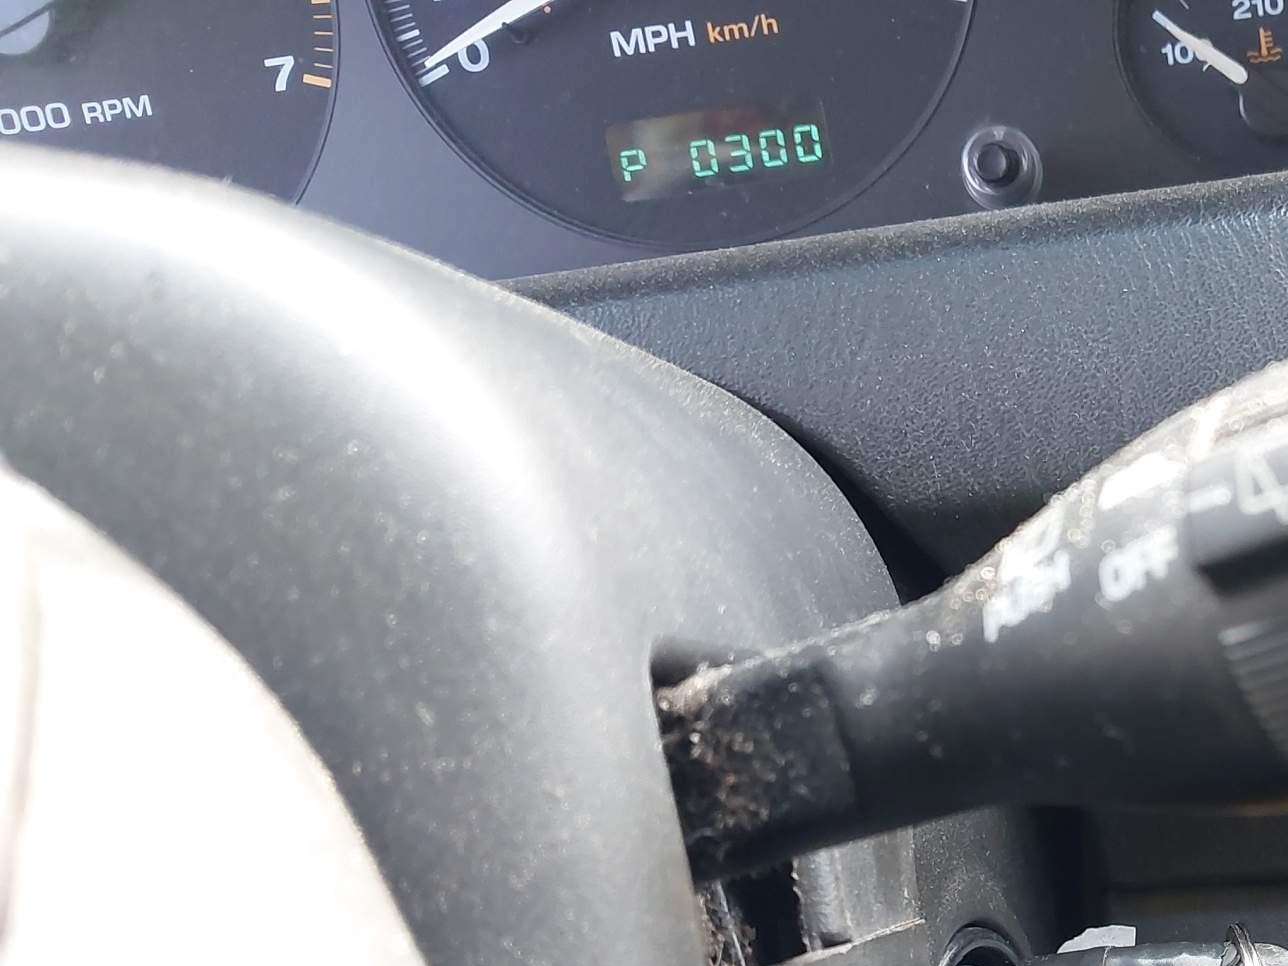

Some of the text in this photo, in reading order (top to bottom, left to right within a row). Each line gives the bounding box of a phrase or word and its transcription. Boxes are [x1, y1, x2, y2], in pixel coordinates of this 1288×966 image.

[609, 13, 780, 57] MPH km/h
[263, 55, 295, 92] 7
[457, 38, 490, 72] 0
[81, 94, 153, 124] RPM
[619, 123, 823, 182] P 0300
